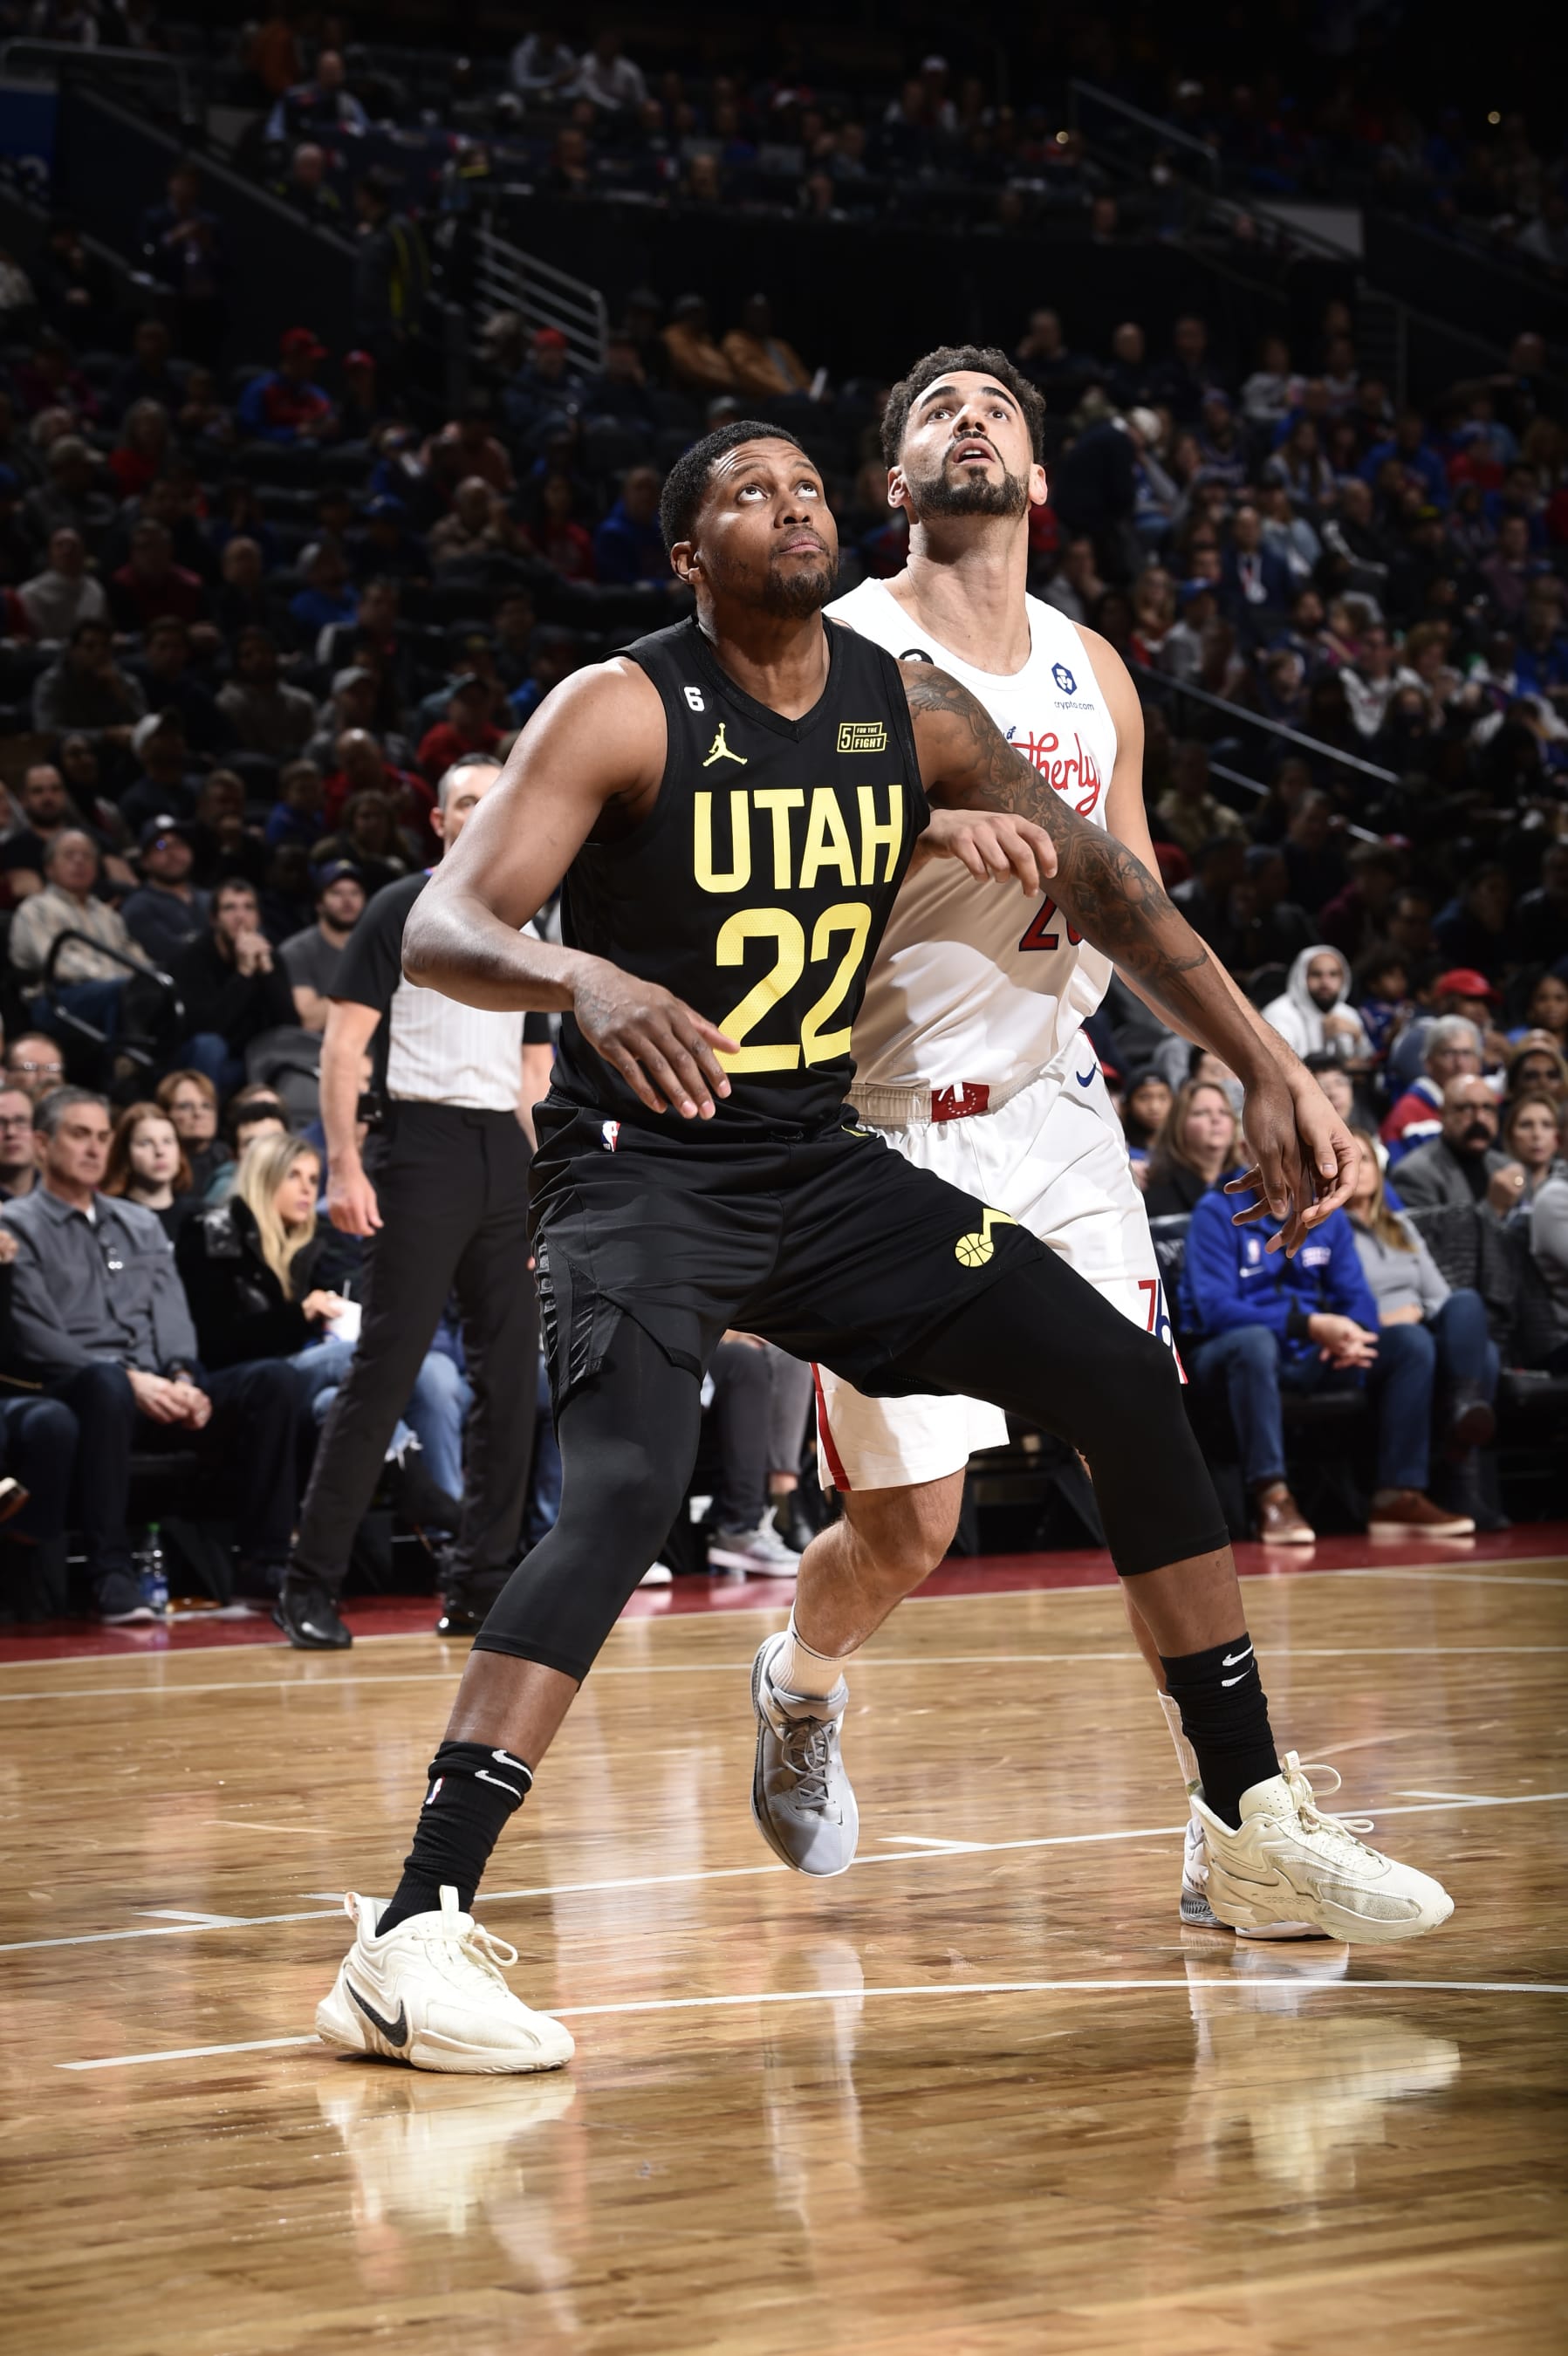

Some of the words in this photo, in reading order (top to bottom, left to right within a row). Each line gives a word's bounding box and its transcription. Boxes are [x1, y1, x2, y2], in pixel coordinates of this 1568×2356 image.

[683, 686, 705, 712] 6
[840, 727, 852, 749] 5
[854, 737, 882, 749] FIGHT
[1010, 731, 1101, 817] therly
[694, 785, 903, 894] UTAH
[716, 902, 872, 1074] 22
